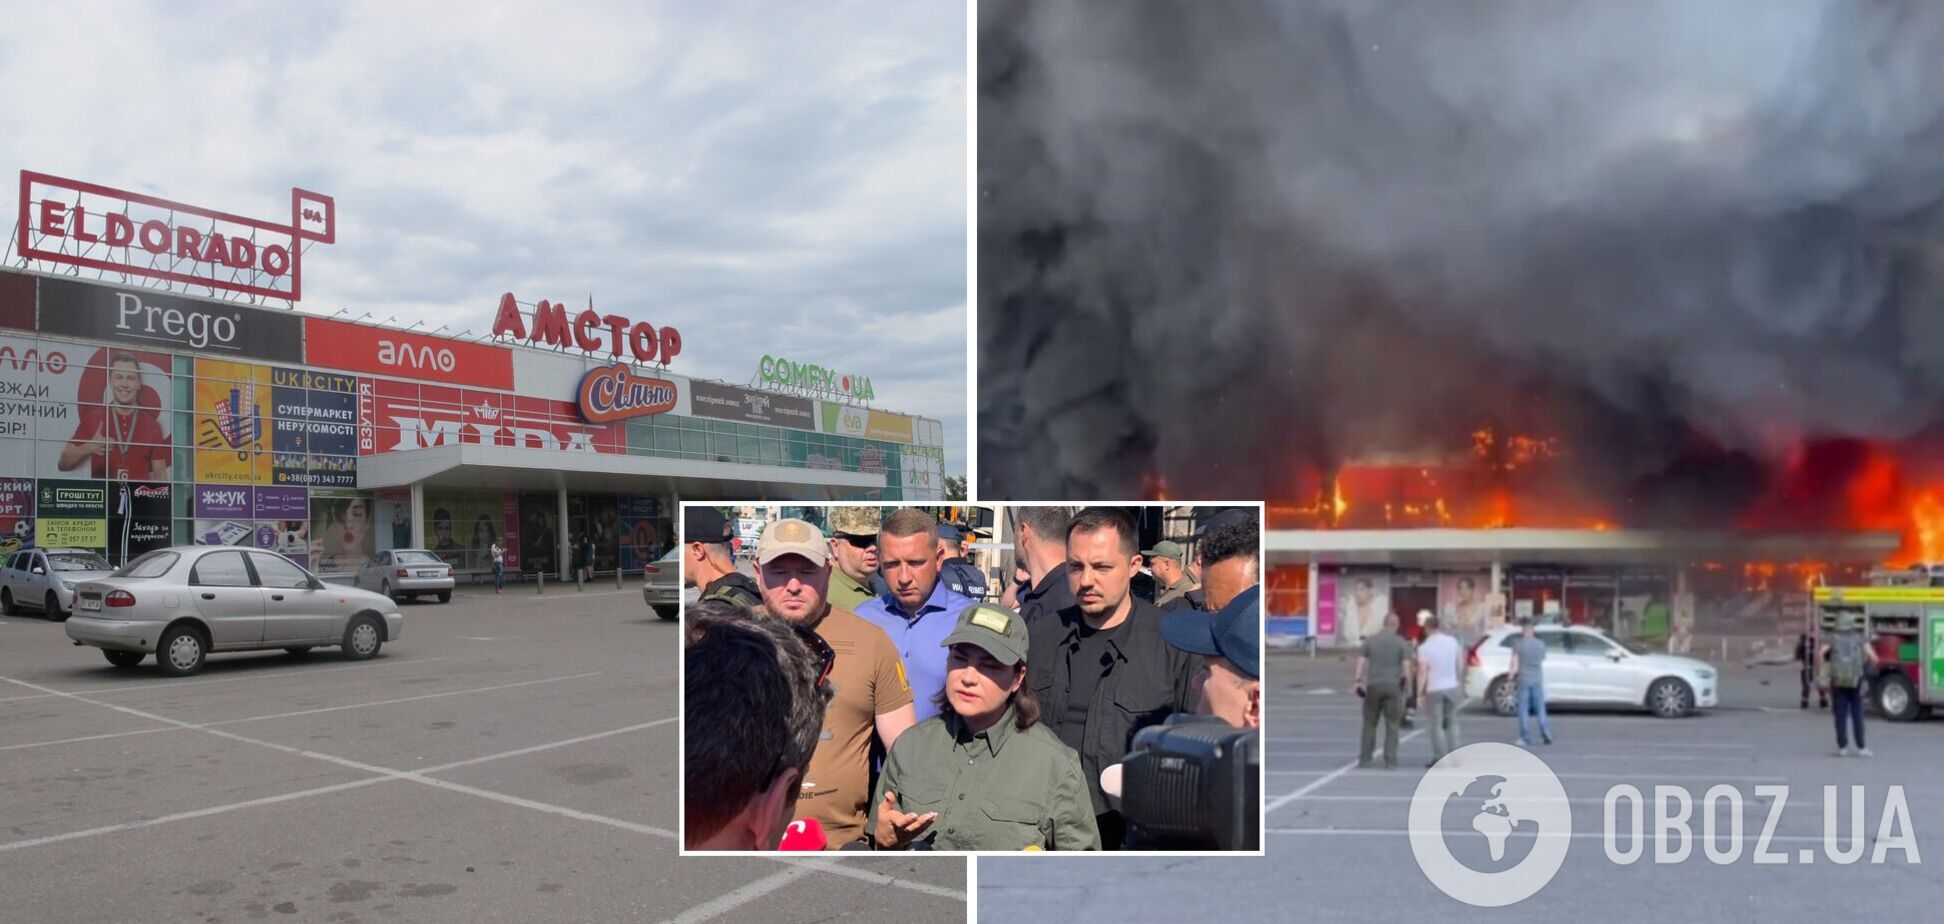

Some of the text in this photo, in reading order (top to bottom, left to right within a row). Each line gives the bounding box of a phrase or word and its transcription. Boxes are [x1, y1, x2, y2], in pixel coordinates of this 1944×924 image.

[303, 208, 322, 223] UA
[40, 199, 290, 277] ELDORADO
[115, 292, 236, 347] Prego
[492, 292, 682, 366] АМСТОР
[274, 370, 355, 392] UKRCITY
[589, 371, 673, 414] Сільпо
[278, 404, 353, 420] СУПЕРМАРКЕТ
[360, 383, 373, 450] ВЗУТТЯ
[278, 421, 354, 435] НЕРУХОМОСТІ
[204, 471, 262, 480] ukrcity.comua
[60, 491, 100, 500] ГРОШІ ТУТ
[202, 490, 247, 507] ЖЖУК
